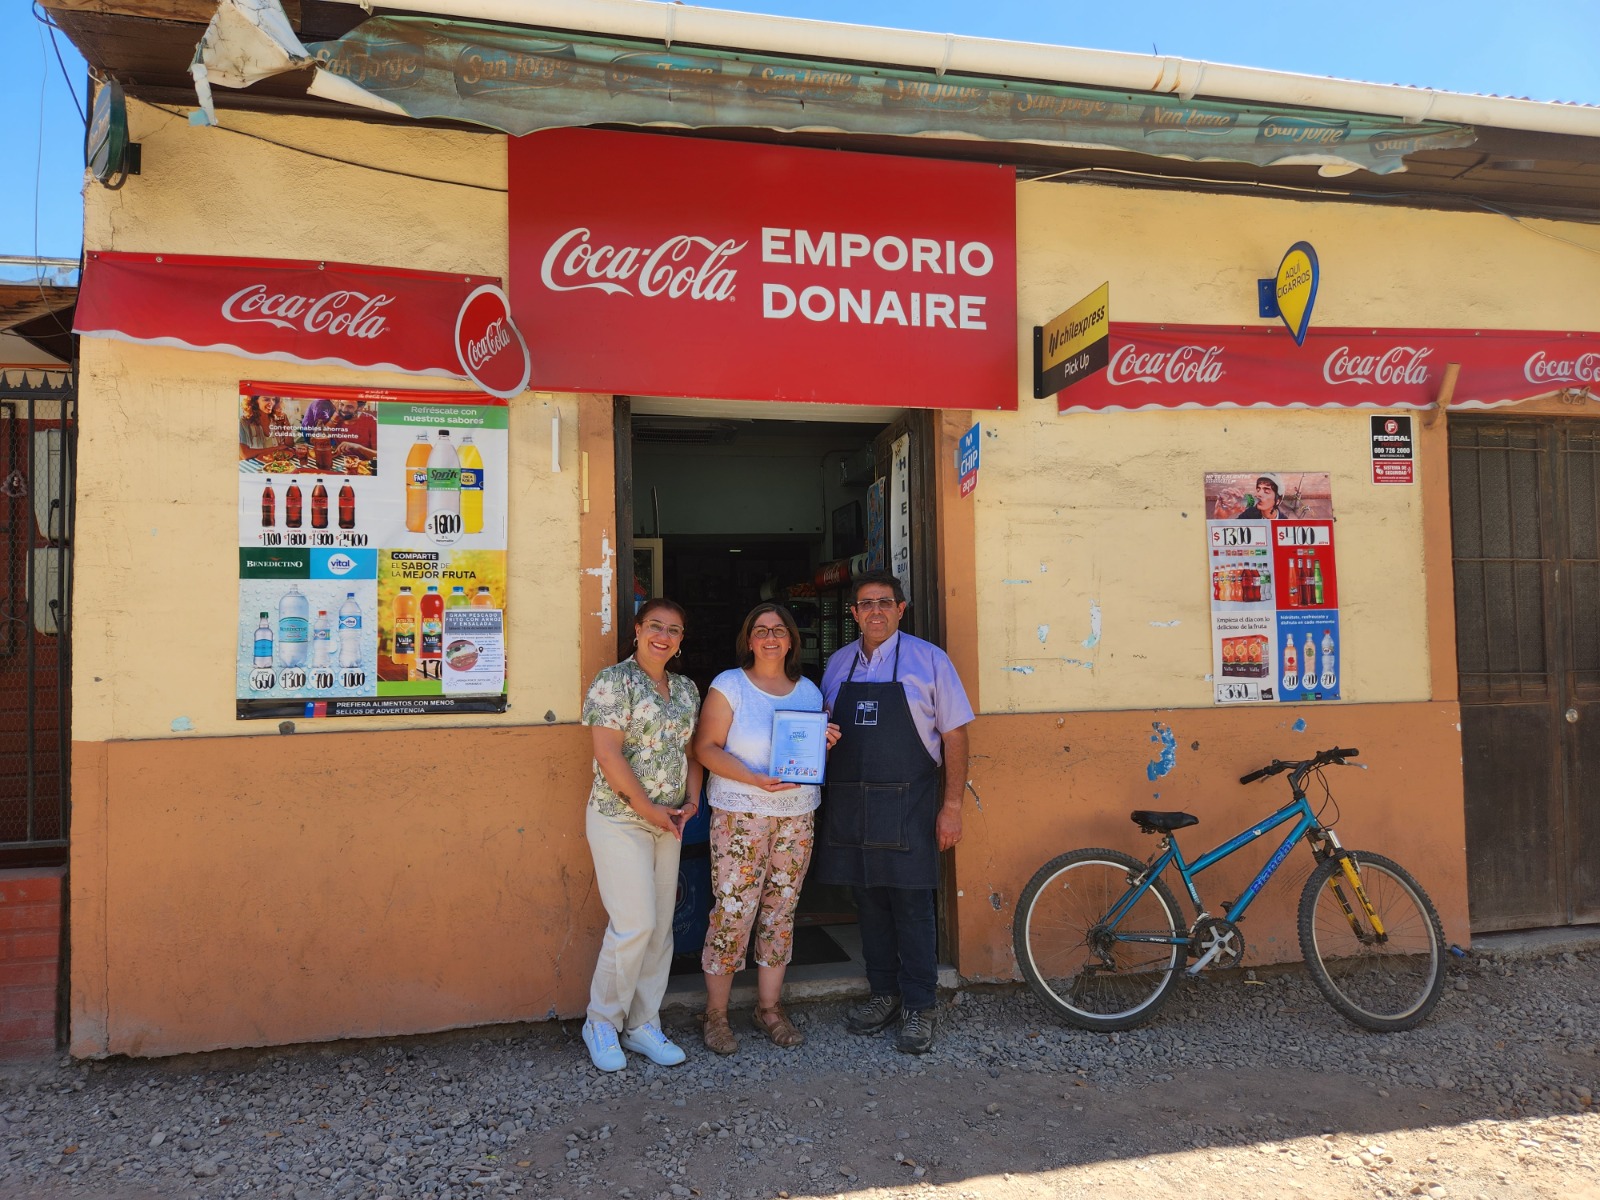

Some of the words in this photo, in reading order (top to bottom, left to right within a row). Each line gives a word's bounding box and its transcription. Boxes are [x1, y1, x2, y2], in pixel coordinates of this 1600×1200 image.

[462, 54, 507, 84] San
[506, 50, 570, 81] Jorge
[540, 227, 749, 302] Coca-Cola
[761, 226, 994, 278] EMPORIO
[1277, 269, 1311, 299] CIGARROS
[221, 284, 396, 339] Coca-Cola
[763, 283, 987, 330] DONAIRE
[1059, 304, 1105, 347] chilexpress
[467, 316, 510, 371] Coca-Cola
[1064, 357, 1079, 379] Pick
[1079, 352, 1090, 371] Up
[1107, 342, 1226, 386] Coca-Cola
[1323, 345, 1435, 385] Coca-Cola
[403, 415, 446, 424] nuestros
[447, 416, 484, 425] sabores
[410, 406, 459, 416] Refréscate
[460, 408, 477, 416] con
[274, 430, 296, 438] cuidas
[431, 469, 459, 481] Sprite
[961, 449, 978, 476] CHIP
[246, 560, 303, 568] BENEDICTINO
[330, 559, 350, 567] vital
[401, 562, 438, 570] SABOR
[403, 570, 440, 579] MEJOR
[442, 570, 477, 579] FRUTA
[421, 658, 442, 679] 17
[1250, 838, 1295, 895] Bianchi
